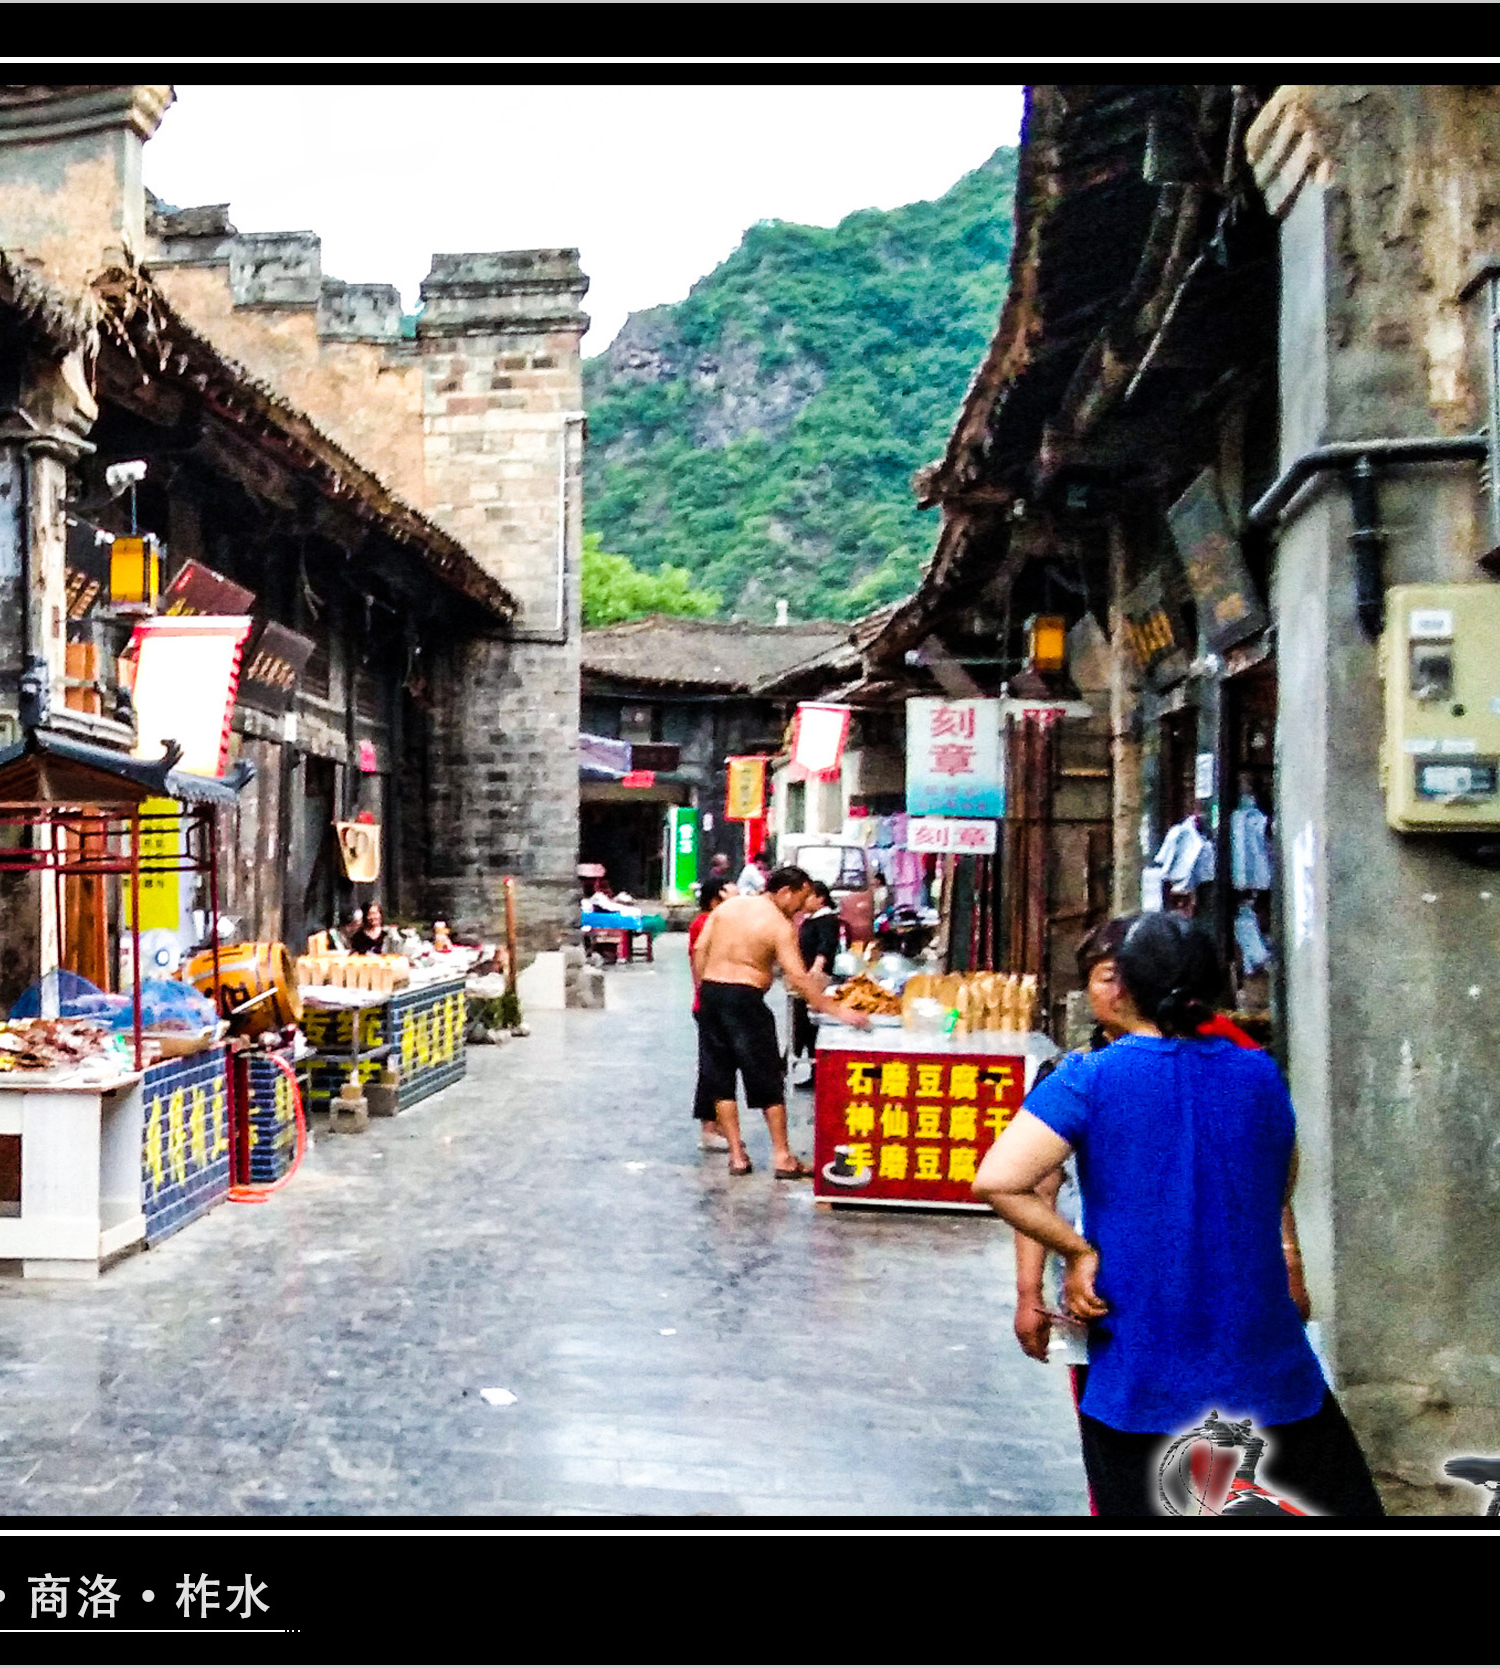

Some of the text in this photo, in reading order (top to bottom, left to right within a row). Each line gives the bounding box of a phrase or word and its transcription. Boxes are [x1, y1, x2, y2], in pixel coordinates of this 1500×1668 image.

[930, 707, 976, 776] 刻章
[914, 825, 987, 848] 刻章
[845, 1101, 1012, 1141] 神仙豆腐干
